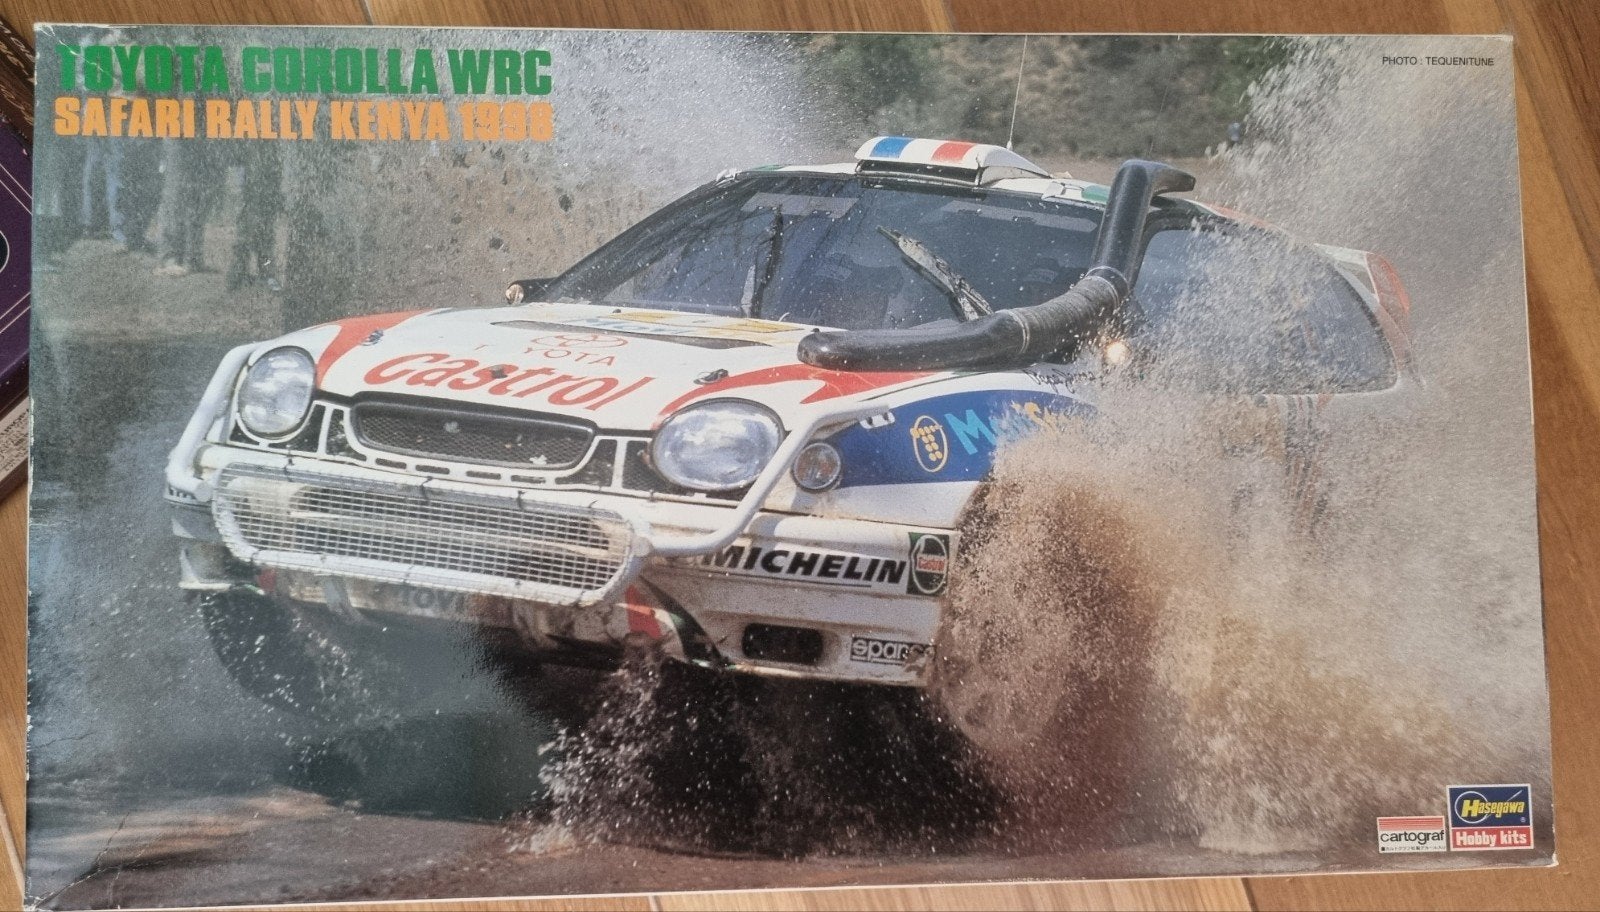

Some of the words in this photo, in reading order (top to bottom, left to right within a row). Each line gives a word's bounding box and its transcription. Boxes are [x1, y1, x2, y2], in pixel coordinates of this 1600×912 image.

[55, 45, 230, 93] TOYOTA
[241, 46, 439, 95] COROLLA
[447, 49, 552, 95] WRC
[1382, 56, 1418, 66] PHOTO
[1425, 56, 1495, 67] TEQUENITUNE
[54, 97, 195, 138] SAFARI
[206, 99, 318, 139] RALLY
[330, 101, 450, 140] KENYA
[458, 102, 554, 142] 1998
[702, 545, 907, 584] MICHELIN
[1461, 799, 1525, 818] Hasegawa
[1380, 829, 1444, 845] cartograf
[1456, 831, 1496, 847] Hobby
[1500, 830, 1526, 845] kits
